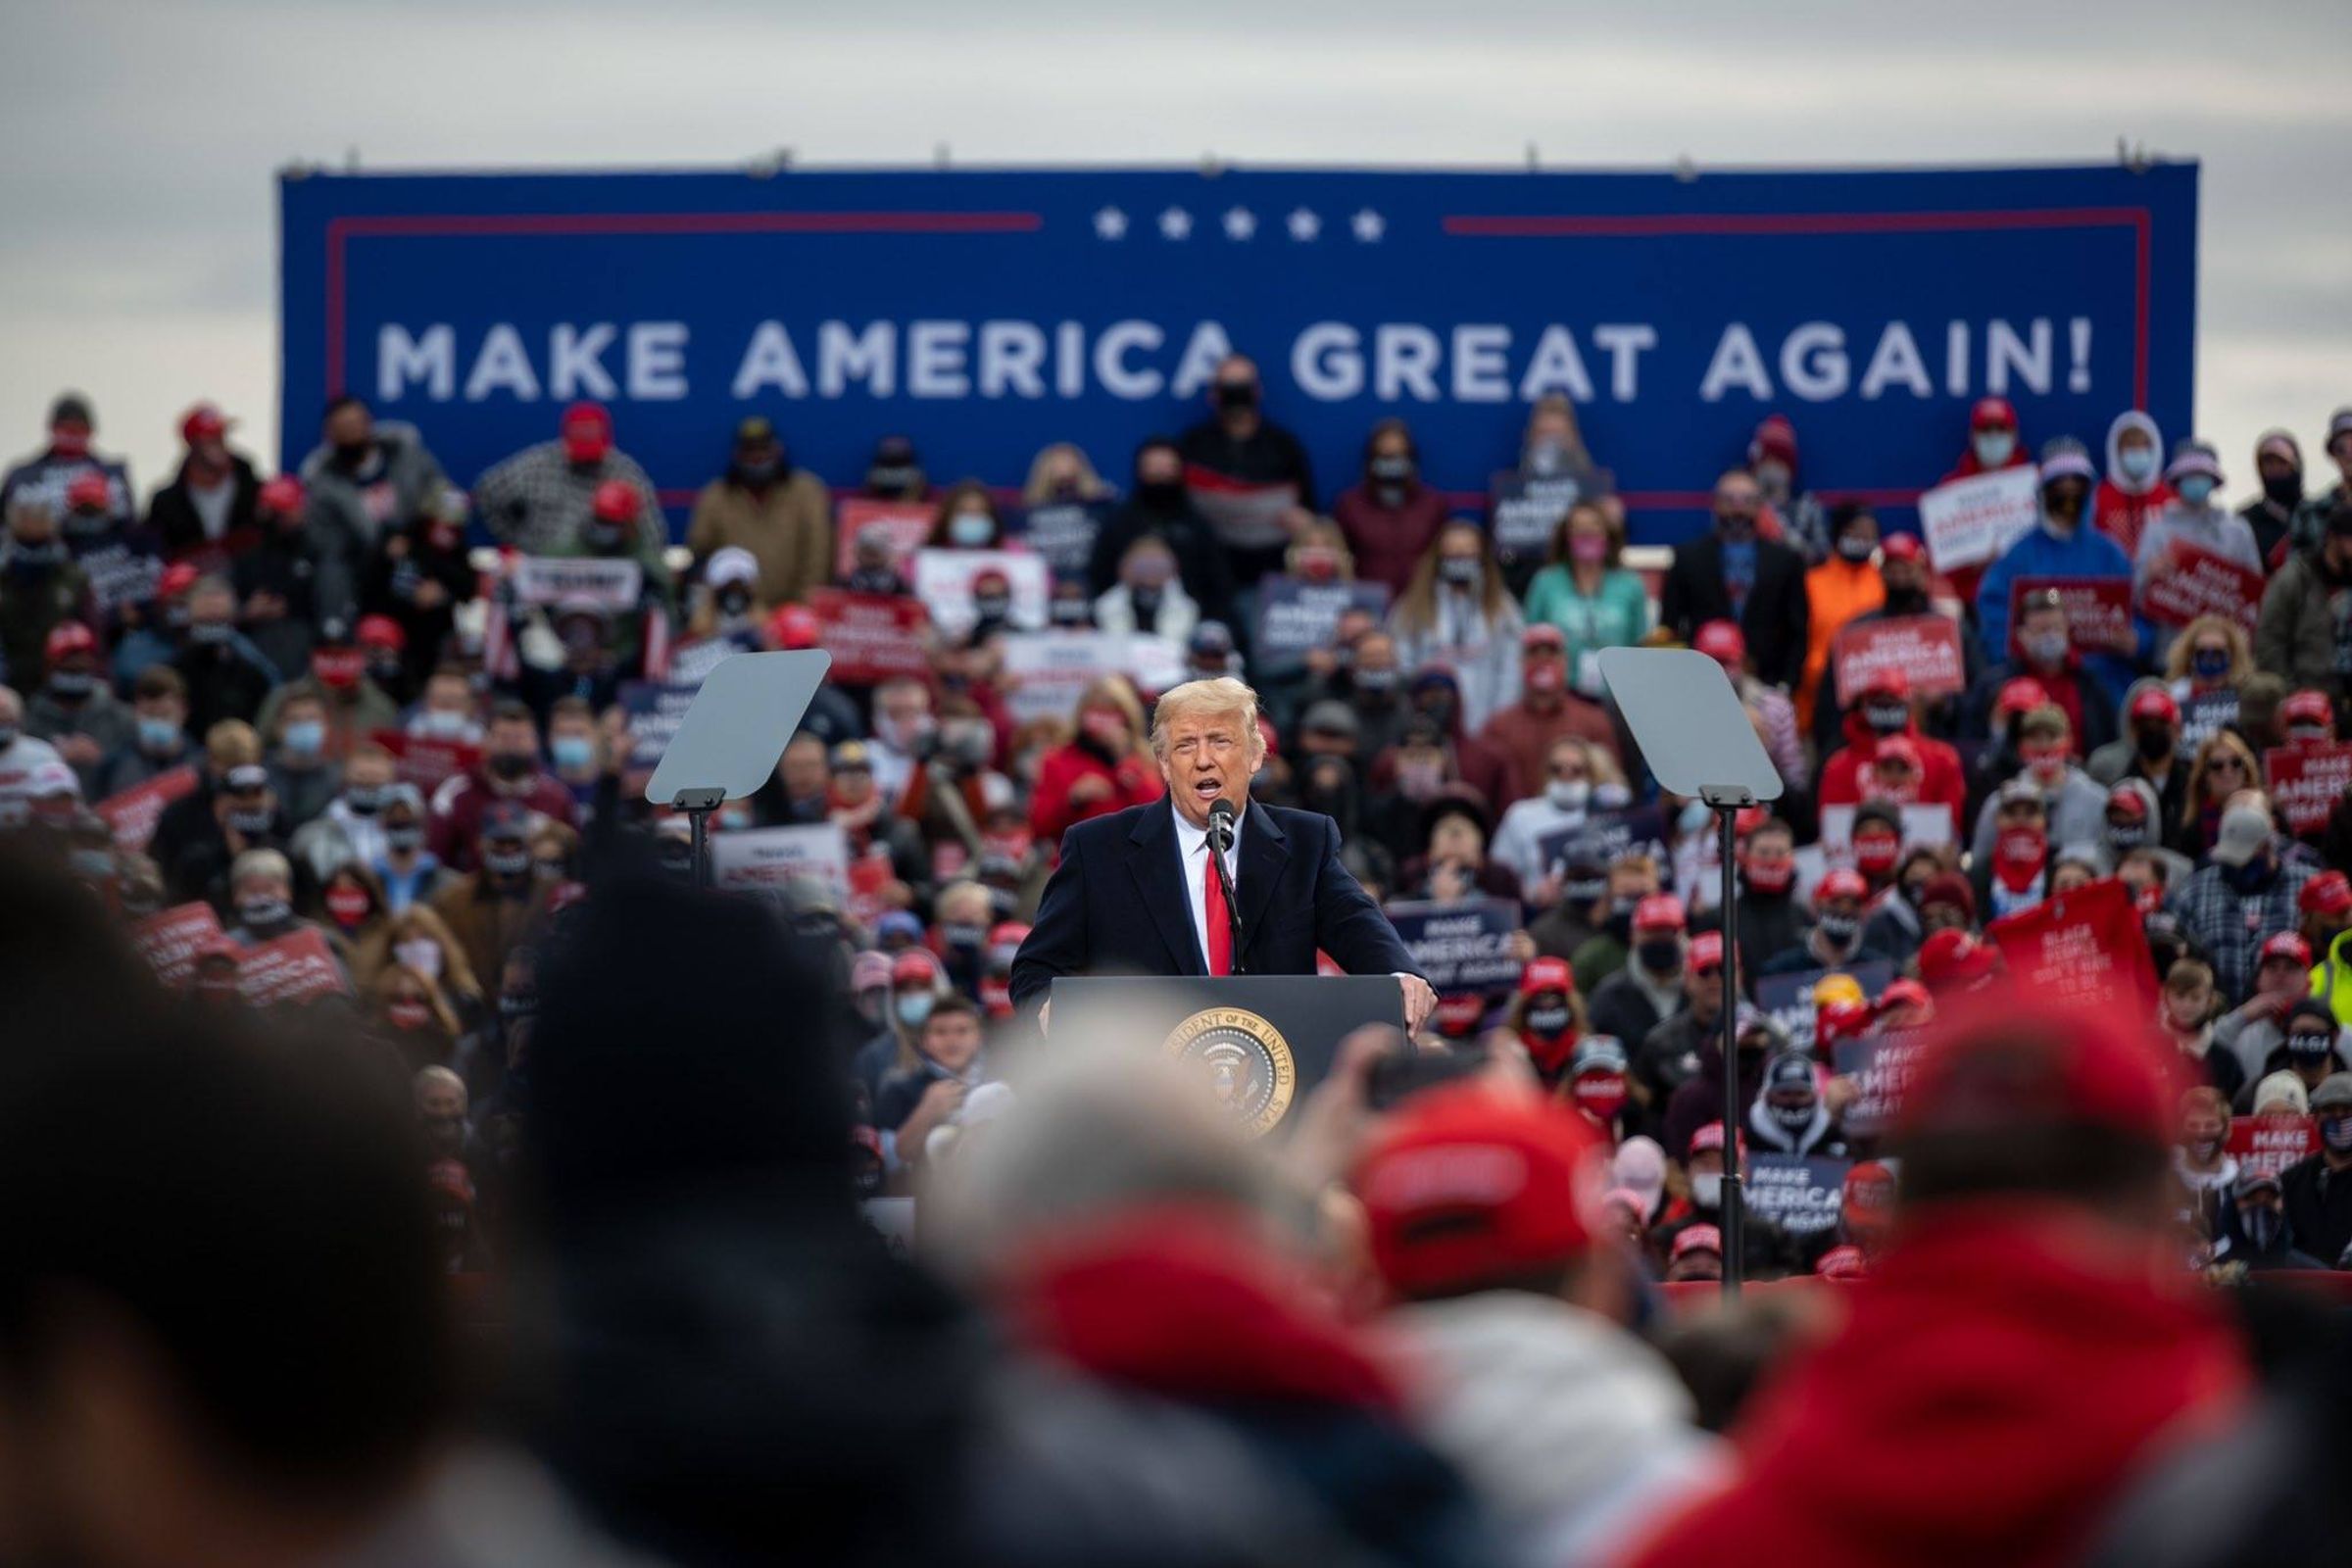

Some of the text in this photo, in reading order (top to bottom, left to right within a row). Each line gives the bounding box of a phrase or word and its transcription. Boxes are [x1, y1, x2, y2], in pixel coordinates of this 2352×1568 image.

[377, 317, 2091, 403] MAKE AMERICA GREAT AGAIN!
[2302, 755, 2352, 775] MAKE
[2273, 777, 2344, 801] AMER
[1242, 1017, 1258, 1029] THE
[1260, 1029, 1290, 1086] UNITED
[2252, 1130, 2309, 1147] MAKE
[1752, 1166, 1811, 1185] MAKE
